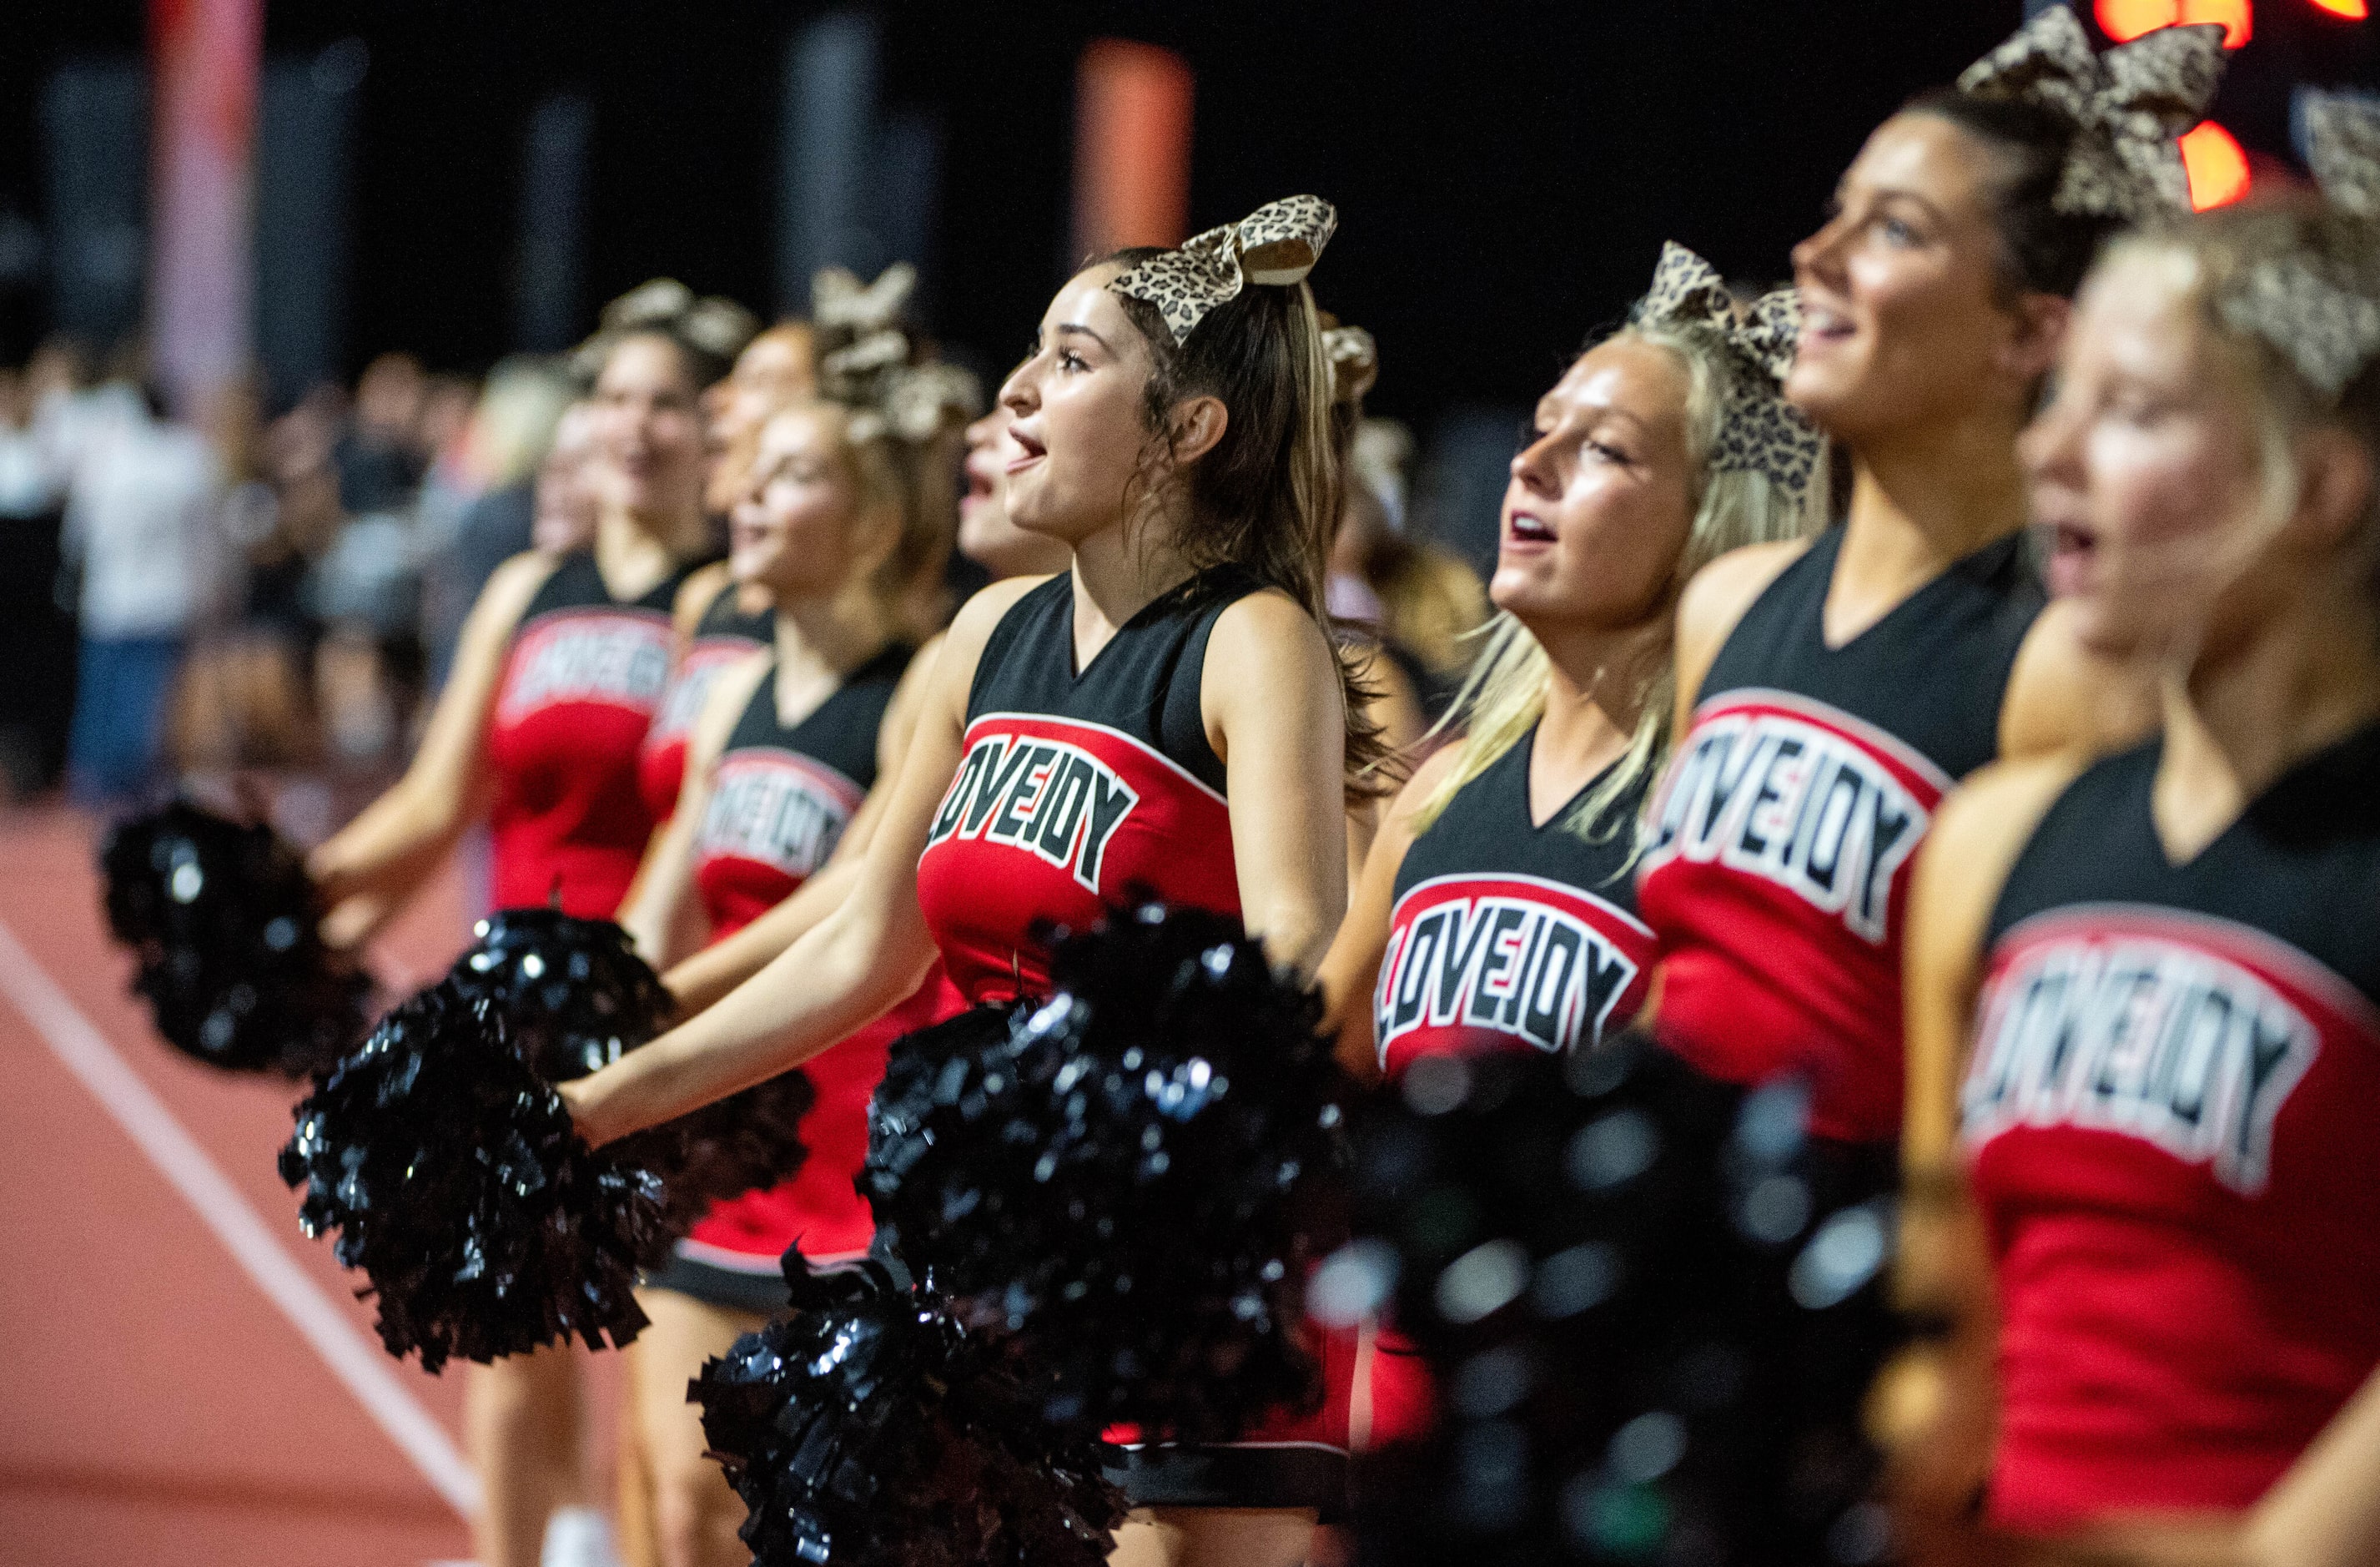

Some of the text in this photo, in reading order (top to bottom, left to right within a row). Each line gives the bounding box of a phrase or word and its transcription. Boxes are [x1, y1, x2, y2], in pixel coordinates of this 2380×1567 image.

[928, 733, 1140, 895] OVEJOY
[1637, 714, 1929, 945] OVEJOY
[1962, 941, 2322, 1198] OVEJOY
